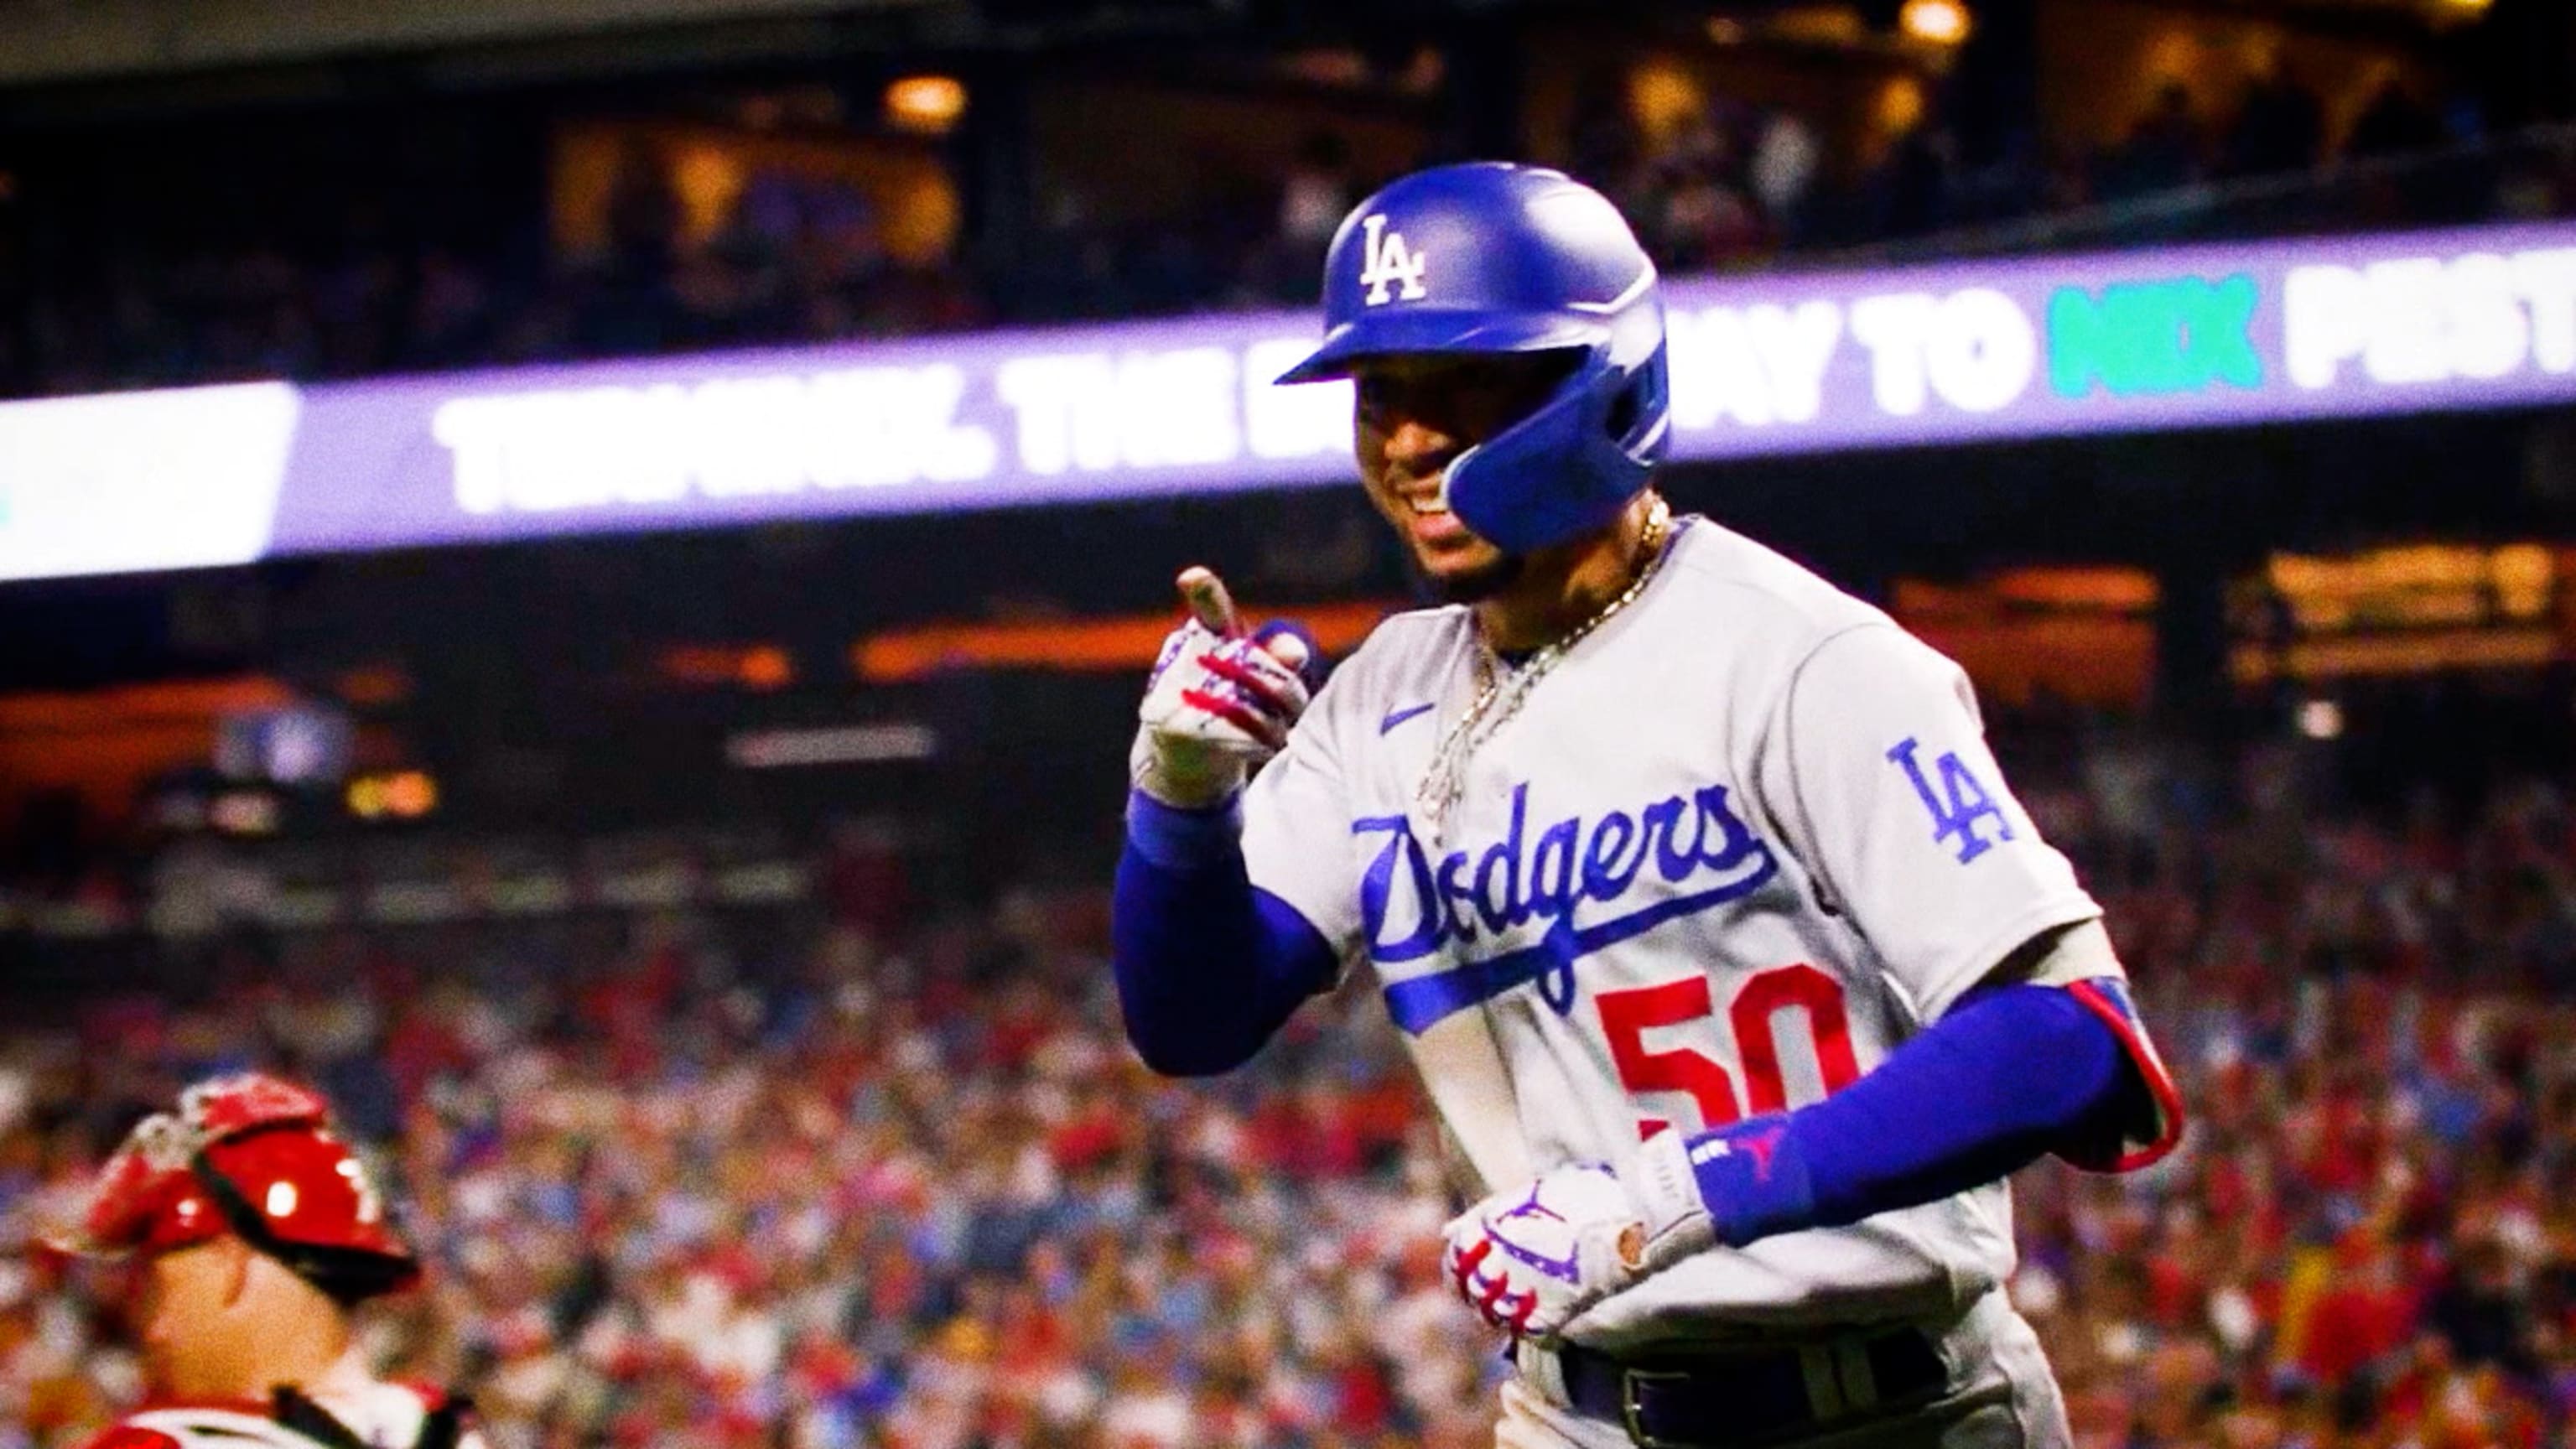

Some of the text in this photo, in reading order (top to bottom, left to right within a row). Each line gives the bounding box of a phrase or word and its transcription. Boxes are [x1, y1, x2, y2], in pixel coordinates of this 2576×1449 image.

[1359, 213, 1427, 306] LA
[998, 348, 1242, 475] THE
[1850, 288, 2035, 415] TO
[1887, 736, 2013, 865] LA
[1352, 782, 1776, 1016] Dodgers
[1594, 963, 1860, 1141] 50
